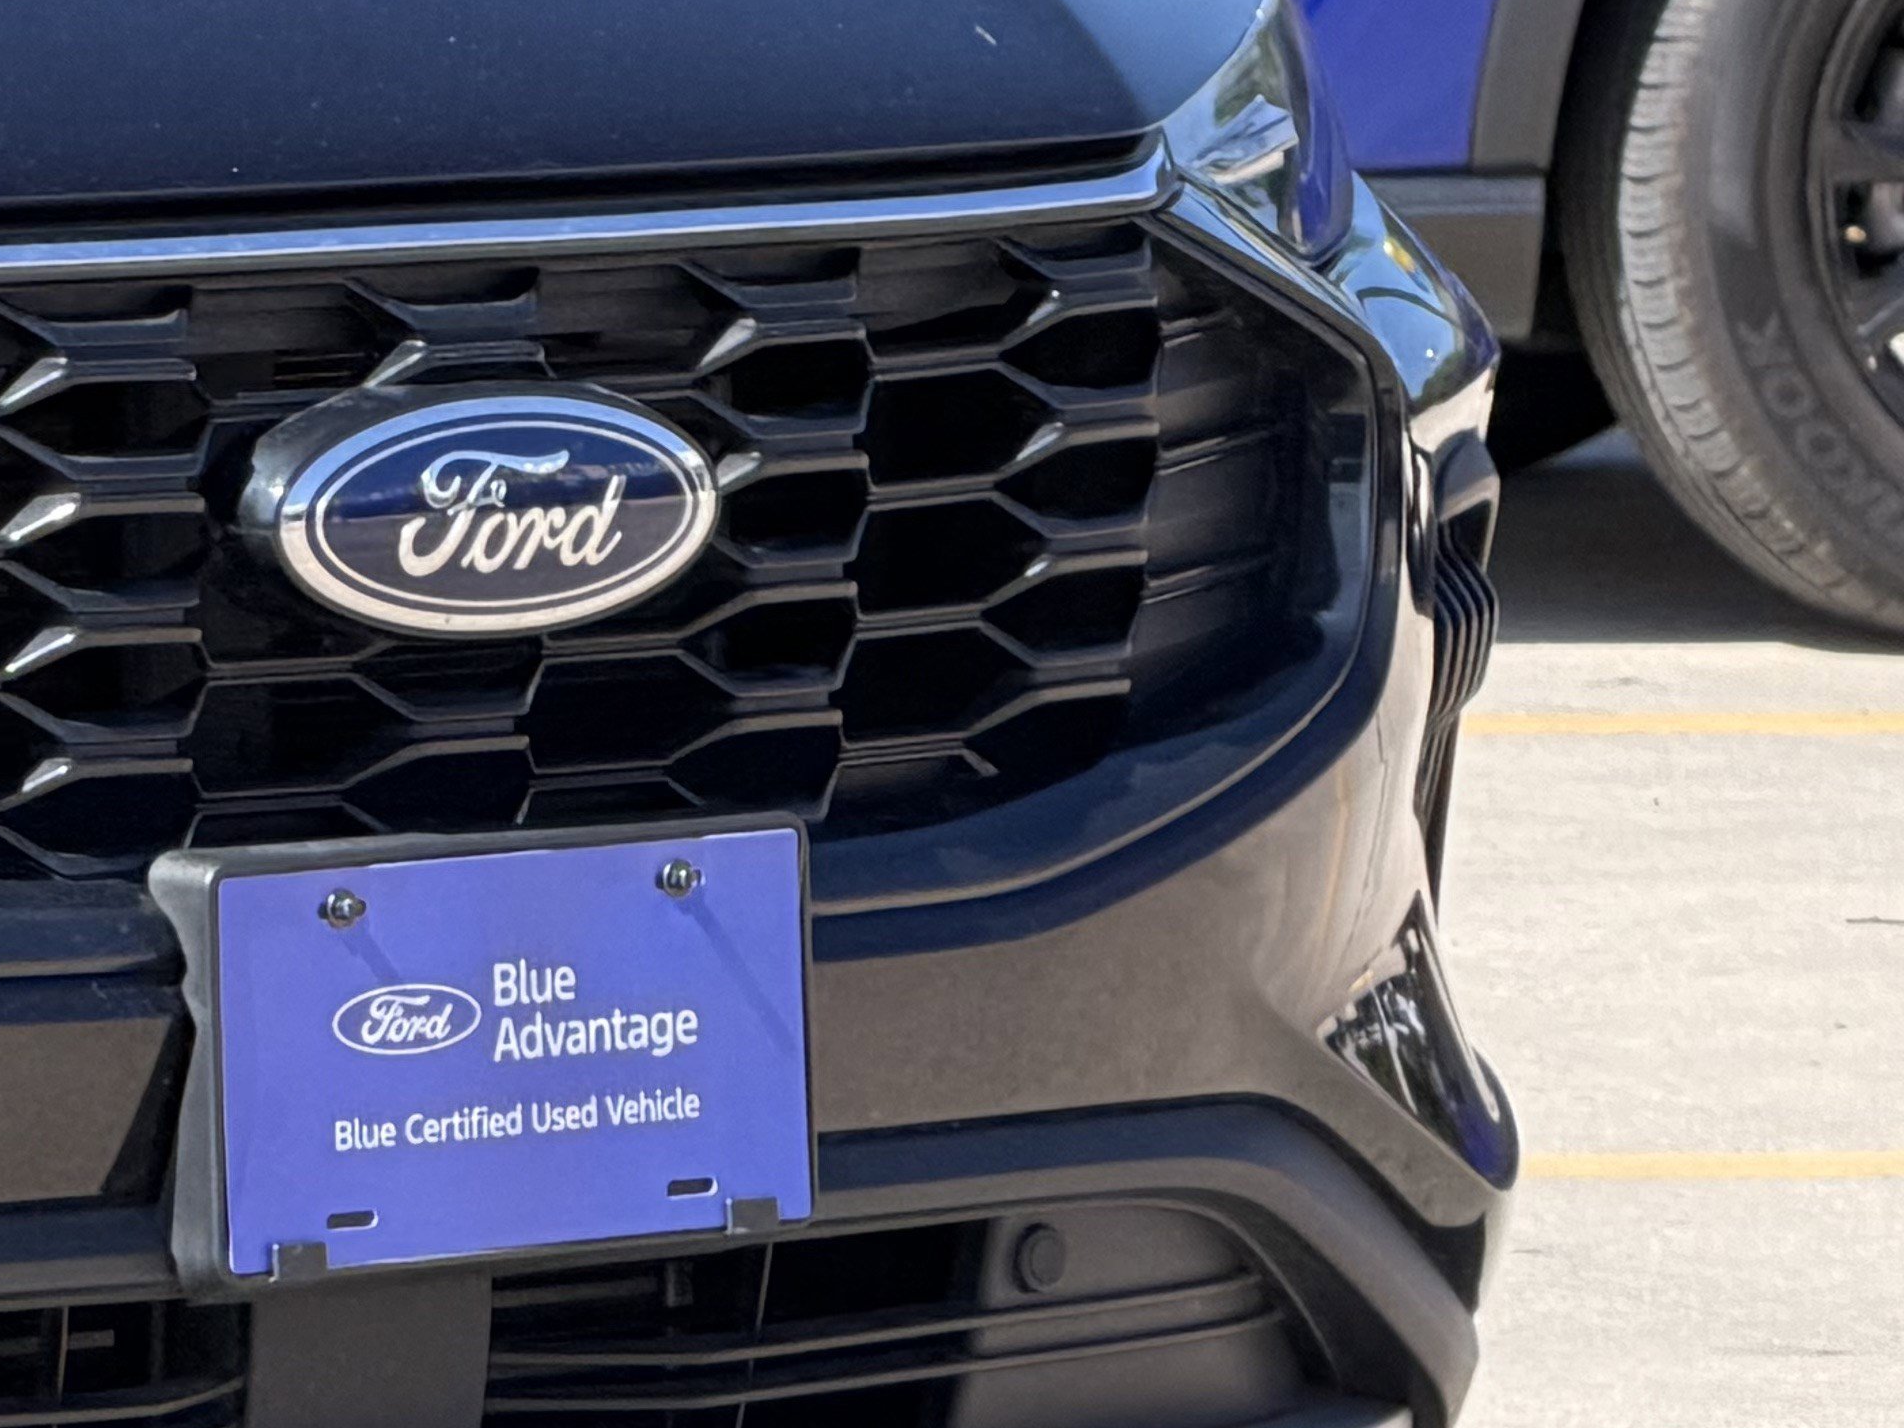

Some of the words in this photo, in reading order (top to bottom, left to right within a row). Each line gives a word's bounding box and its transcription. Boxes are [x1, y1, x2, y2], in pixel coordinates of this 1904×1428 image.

[399, 449, 627, 578] Ford
[493, 958, 577, 1007] Blue
[361, 994, 454, 1045] Ford
[494, 1008, 699, 1063] Advantage
[335, 1117, 397, 1151] Blue
[405, 1102, 523, 1144] Certified
[531, 1094, 598, 1134] Used
[605, 1086, 701, 1126] Vehicle
